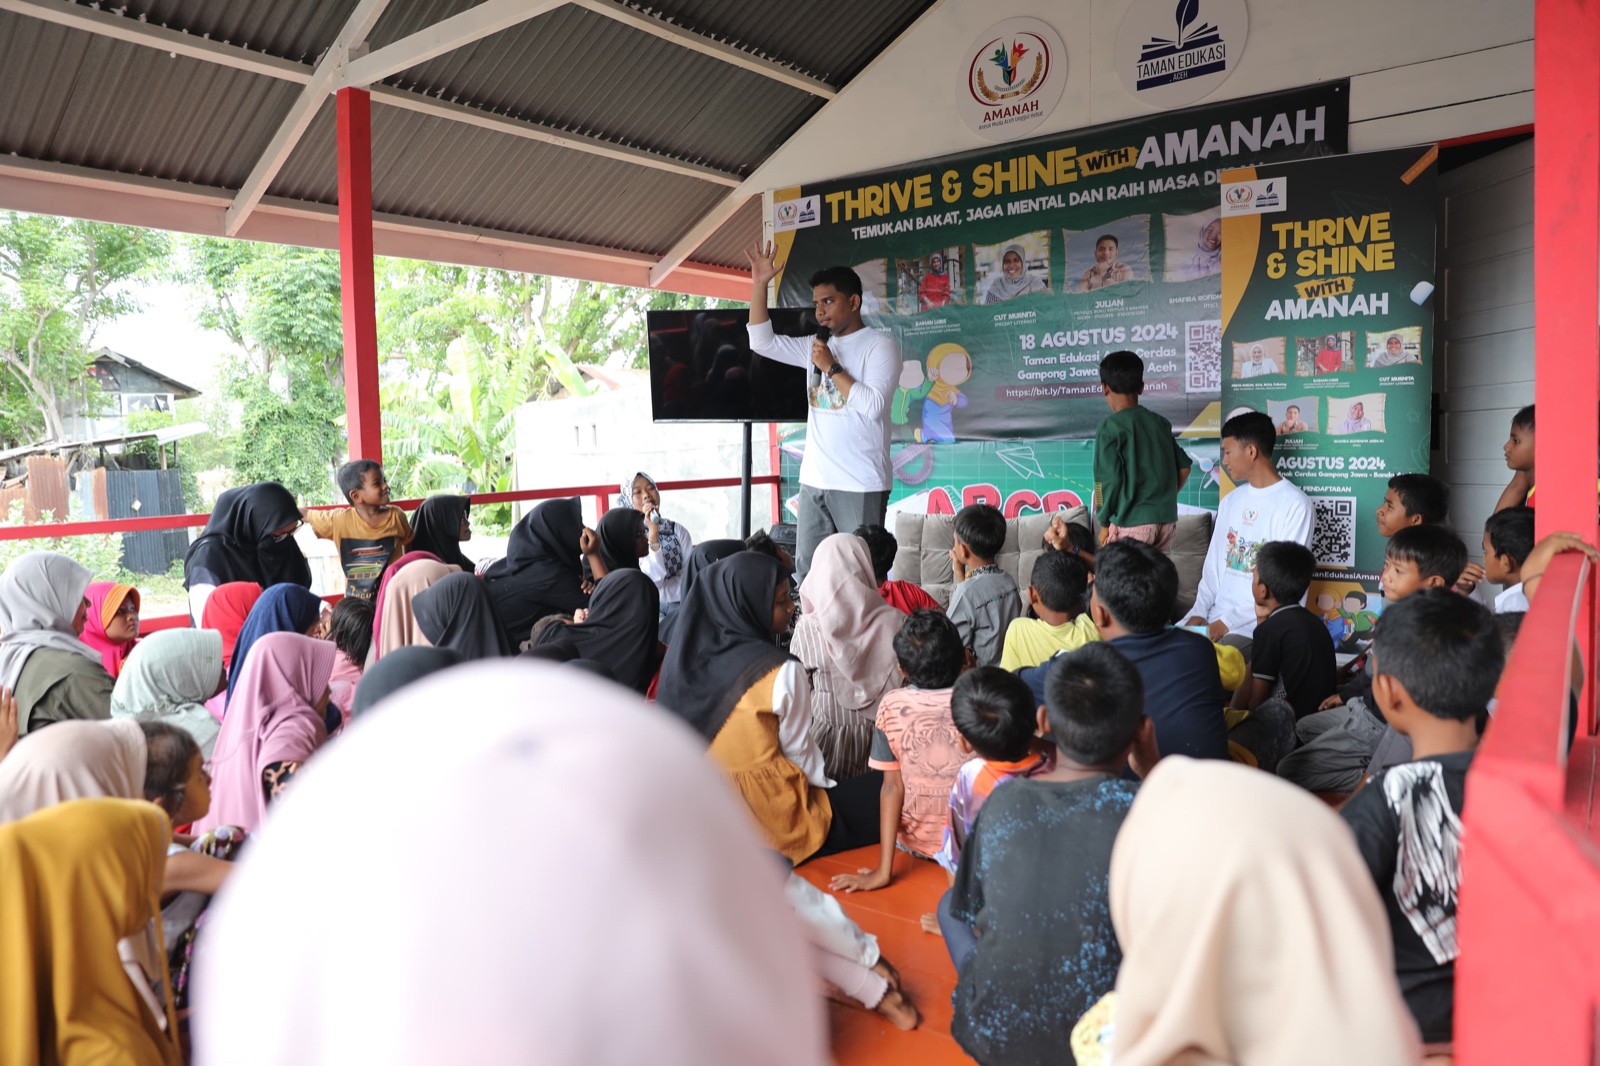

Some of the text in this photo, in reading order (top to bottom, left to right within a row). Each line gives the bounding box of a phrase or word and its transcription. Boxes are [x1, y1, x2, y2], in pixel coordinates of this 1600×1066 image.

[1137, 44, 1226, 79] TAMAN EDUKASI
[1173, 71, 1188, 81] ACEH
[983, 100, 1039, 123] AMANAH
[825, 105, 1326, 224] THRIVE & SHINE WITH AMANAH
[851, 174, 1200, 240] TEMUKAN BAKAT, JAGA MENTAL DAN RAIH MASA
[1271, 211, 1391, 250] THRIVE
[1266, 241, 1396, 280] & SHINE
[1304, 279, 1346, 298] WITH
[1095, 299, 1124, 308] JULIAN
[1264, 292, 1389, 321] AMANAH
[1008, 311, 1037, 320] MURNITA
[1019, 322, 1179, 351] 18 AGUSTUS 2024
[1023, 355, 1057, 366] Taman
[1059, 350, 1100, 364] Edukasi
[1135, 346, 1177, 359] Cerdas
[1017, 361, 1177, 382] Gampong Jawa Aceh
[1276, 456, 1386, 470] AGUSTUS 2024
[1318, 471, 1349, 479] Gampong
